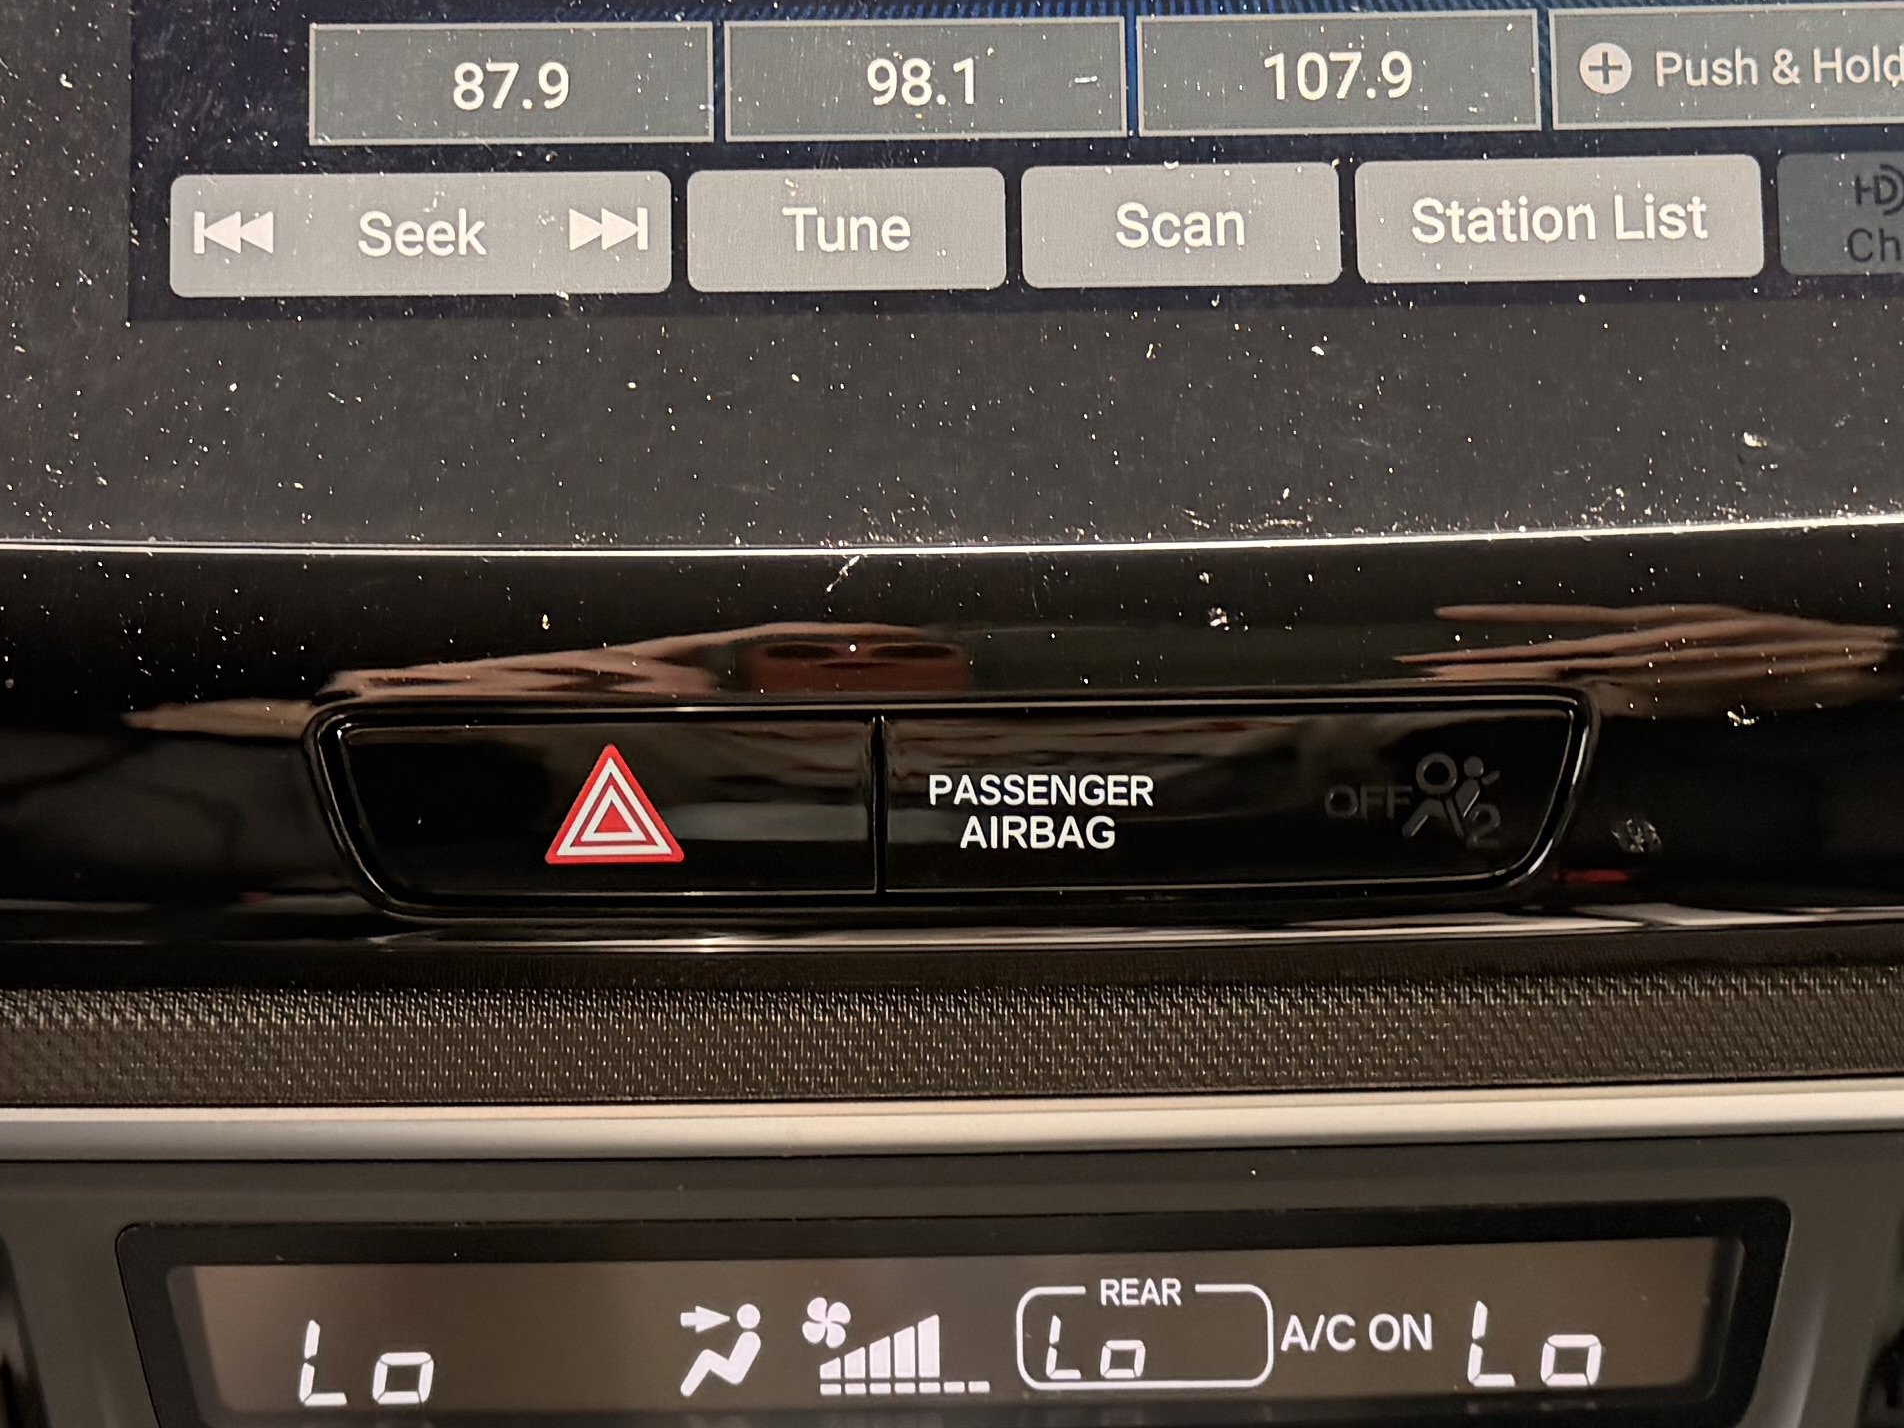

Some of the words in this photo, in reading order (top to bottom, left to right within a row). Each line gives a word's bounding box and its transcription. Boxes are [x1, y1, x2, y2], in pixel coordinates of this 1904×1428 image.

[452, 62, 571, 110] 87.9
[865, 58, 978, 107] 98.1
[1263, 51, 1413, 101] 107.9
[1655, 49, 1759, 88] Push
[1772, 49, 1802, 85] &
[357, 210, 487, 258] Seek
[783, 205, 912, 254] Tune
[1114, 200, 1246, 248] Scan
[1412, 197, 1597, 244] Station
[1615, 195, 1707, 241] List
[928, 775, 1154, 808] PASSENGER
[1324, 785, 1413, 821] OFF
[961, 815, 1116, 851] AIRBAG
[1100, 1278, 1181, 1307] REAR
[1045, 1314, 1145, 1380] Lo
[1281, 1314, 1356, 1353] A/C
[1369, 1314, 1432, 1350] ON
[1467, 1301, 1602, 1388] Lo
[299, 1319, 434, 1406] Lo
